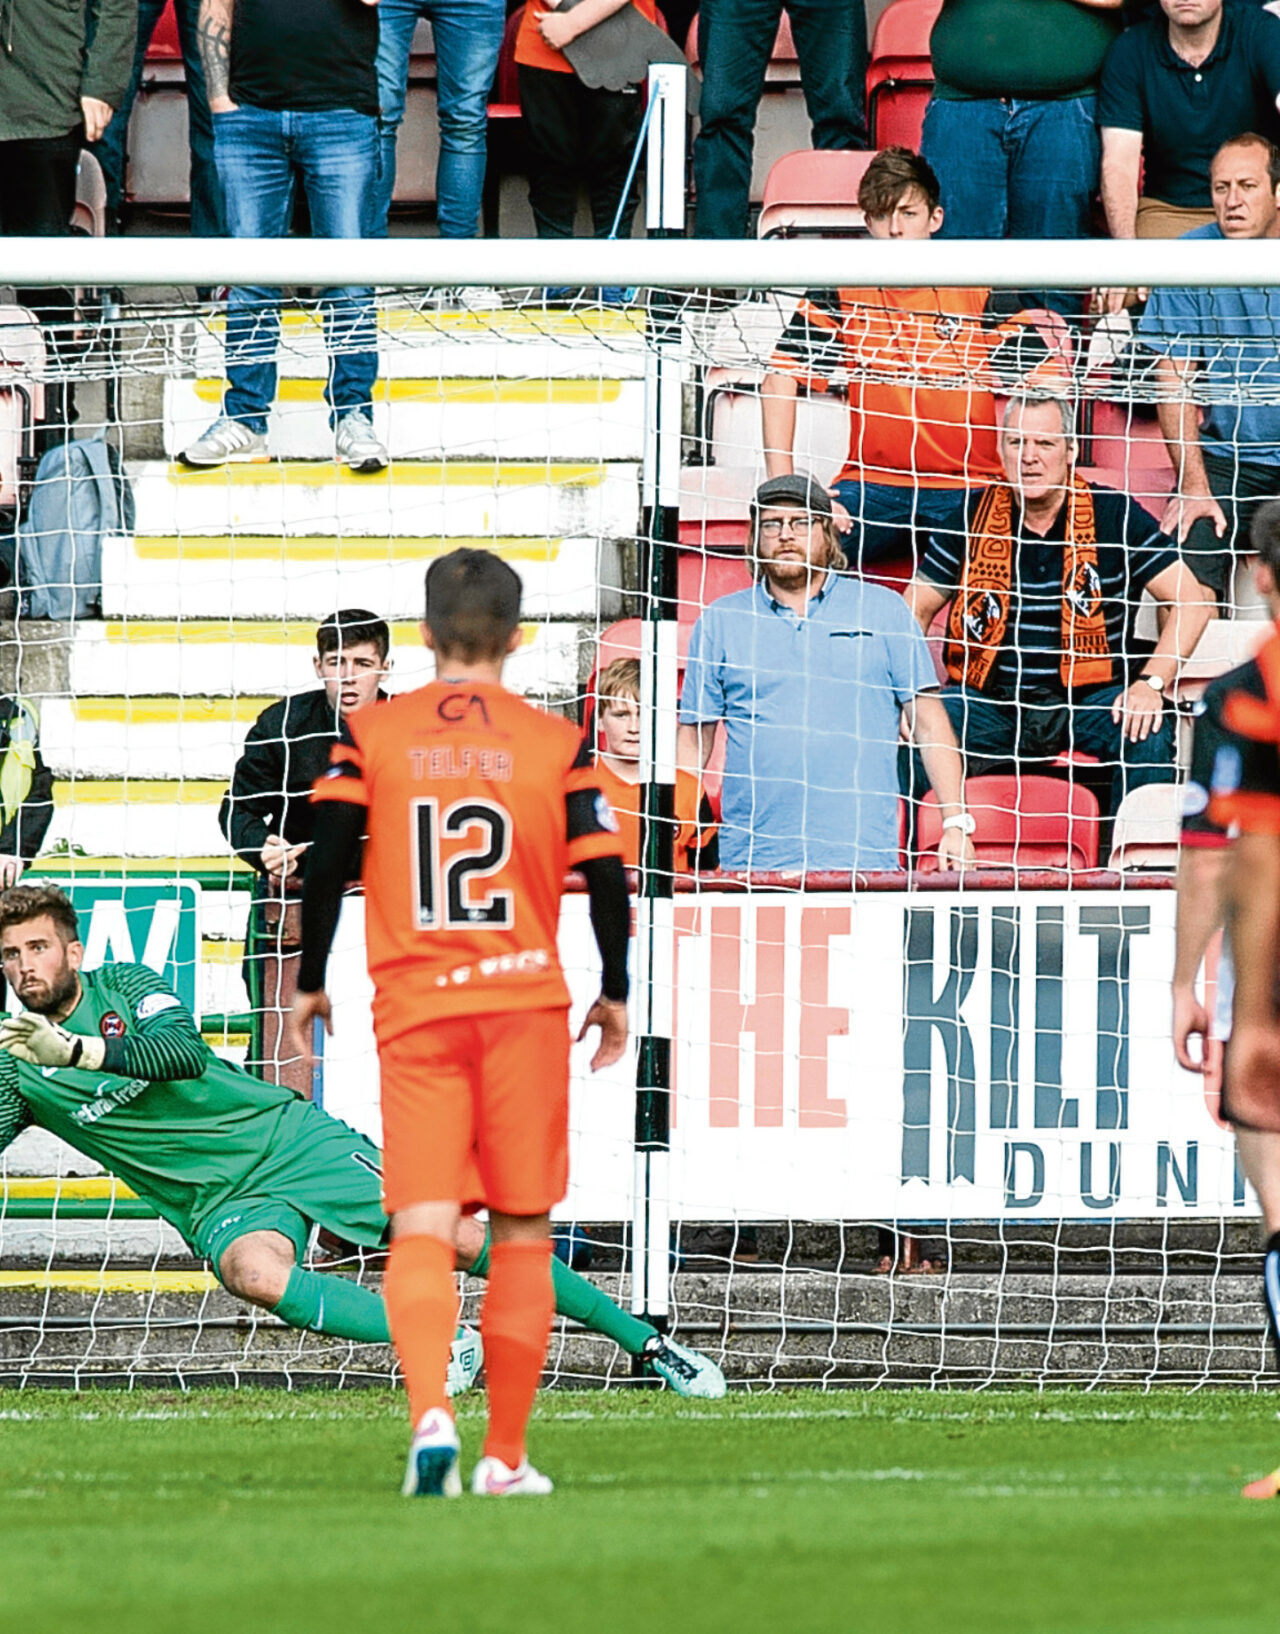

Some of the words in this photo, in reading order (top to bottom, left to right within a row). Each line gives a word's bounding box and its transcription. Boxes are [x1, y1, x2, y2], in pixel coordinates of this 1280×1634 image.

[408, 746, 512, 782] TELFER
[410, 797, 513, 930] 12
[901, 906, 1152, 1187] KILT
